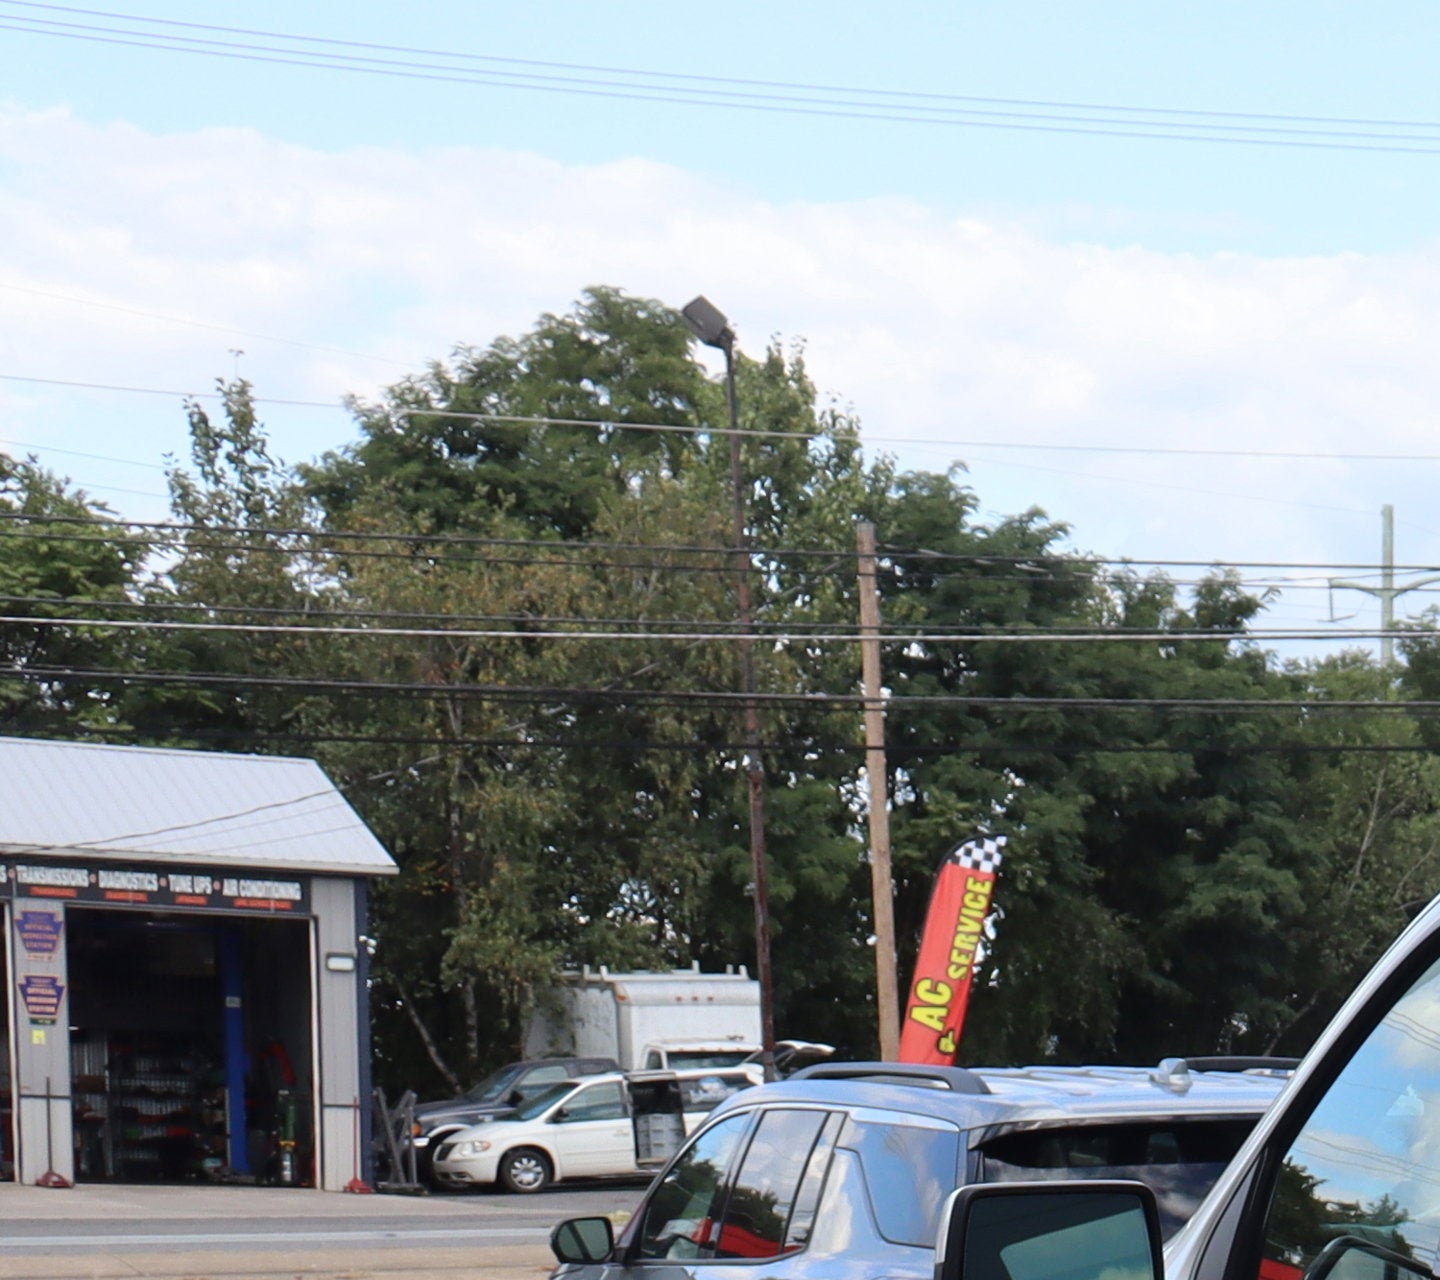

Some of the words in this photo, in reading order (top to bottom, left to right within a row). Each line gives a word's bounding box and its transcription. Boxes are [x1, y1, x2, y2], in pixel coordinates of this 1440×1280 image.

[16, 865, 89, 888] TRANSMISSIONS
[910, 976, 953, 1033] AC
[947, 876, 994, 980] SERVICE
